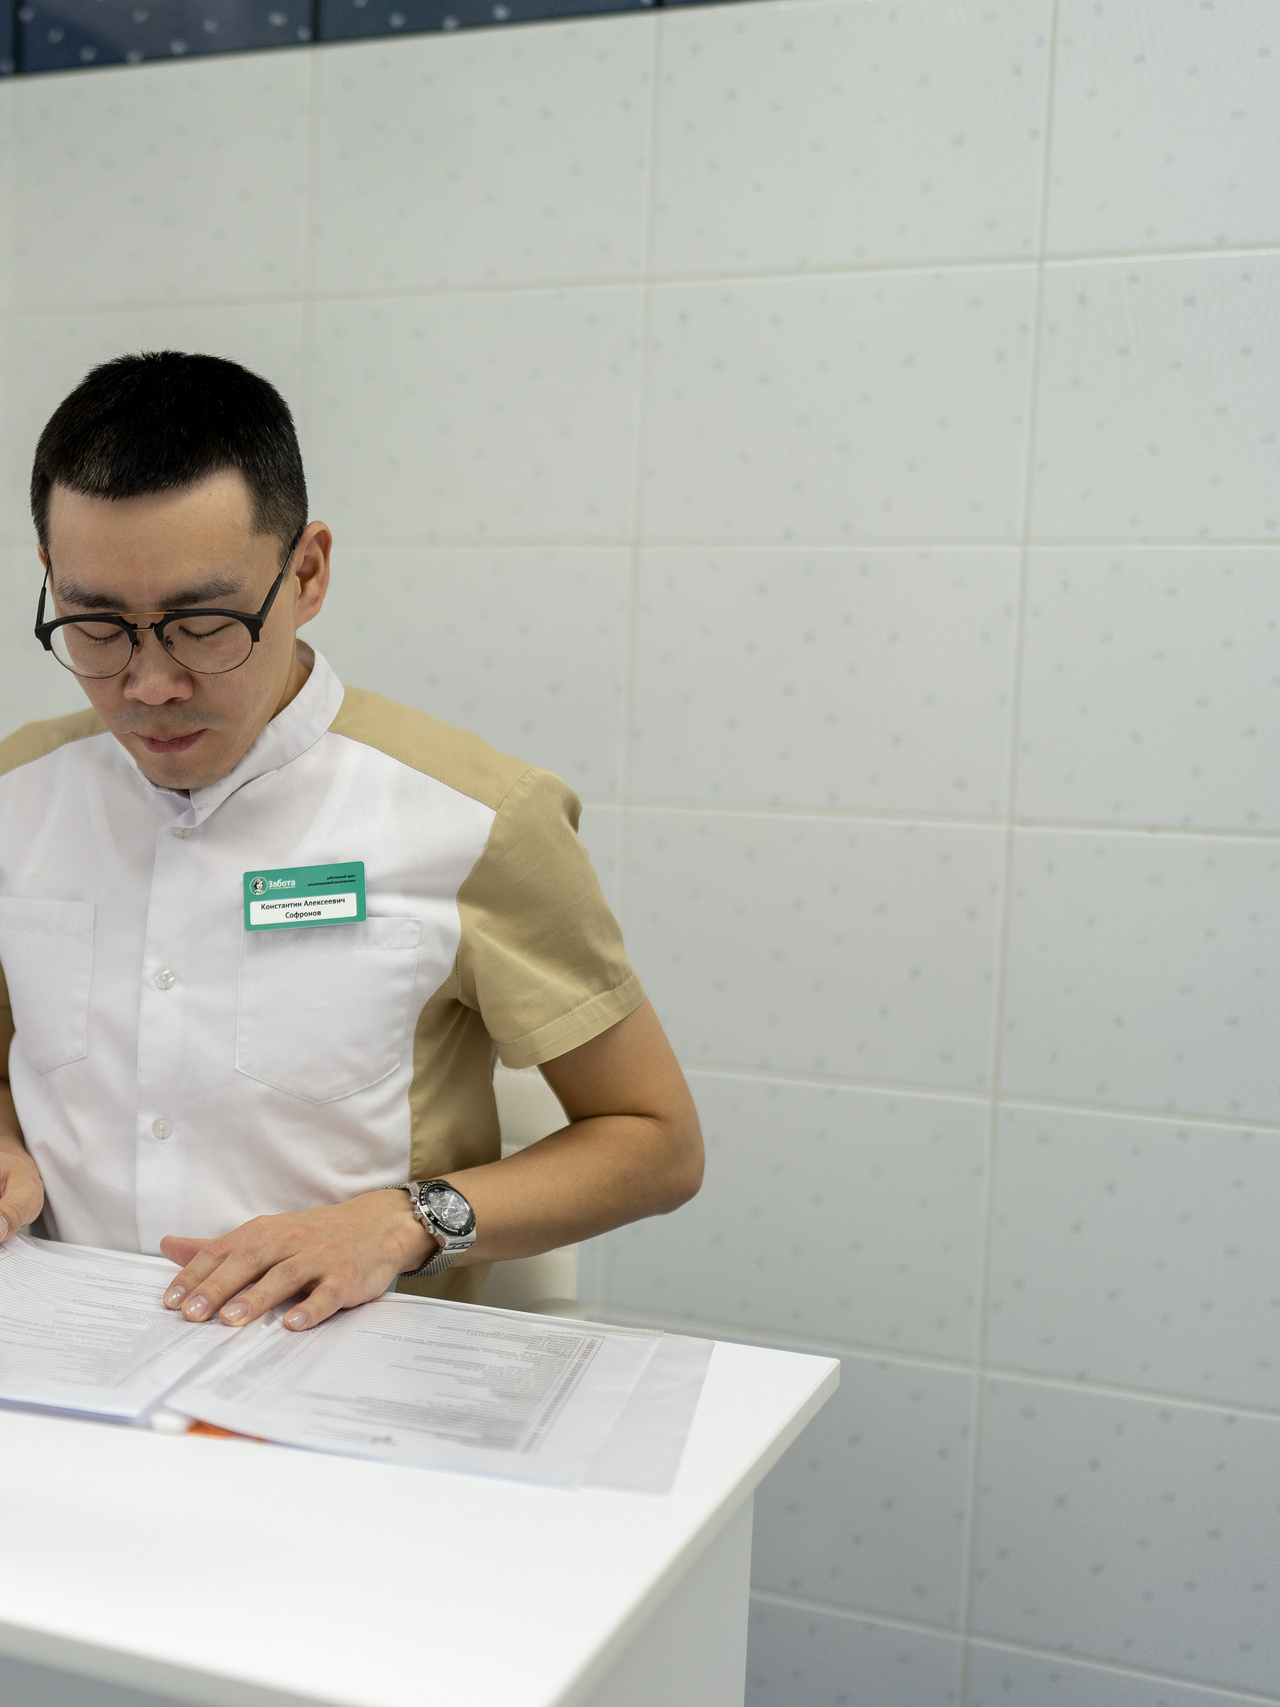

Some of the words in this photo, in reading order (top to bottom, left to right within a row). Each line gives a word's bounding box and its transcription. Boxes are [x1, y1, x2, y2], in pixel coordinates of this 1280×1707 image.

[268, 879, 296, 888] Забота
[261, 902, 302, 910] Константин
[303, 898, 346, 907] Алексеевич
[285, 910, 322, 919] Софронов
